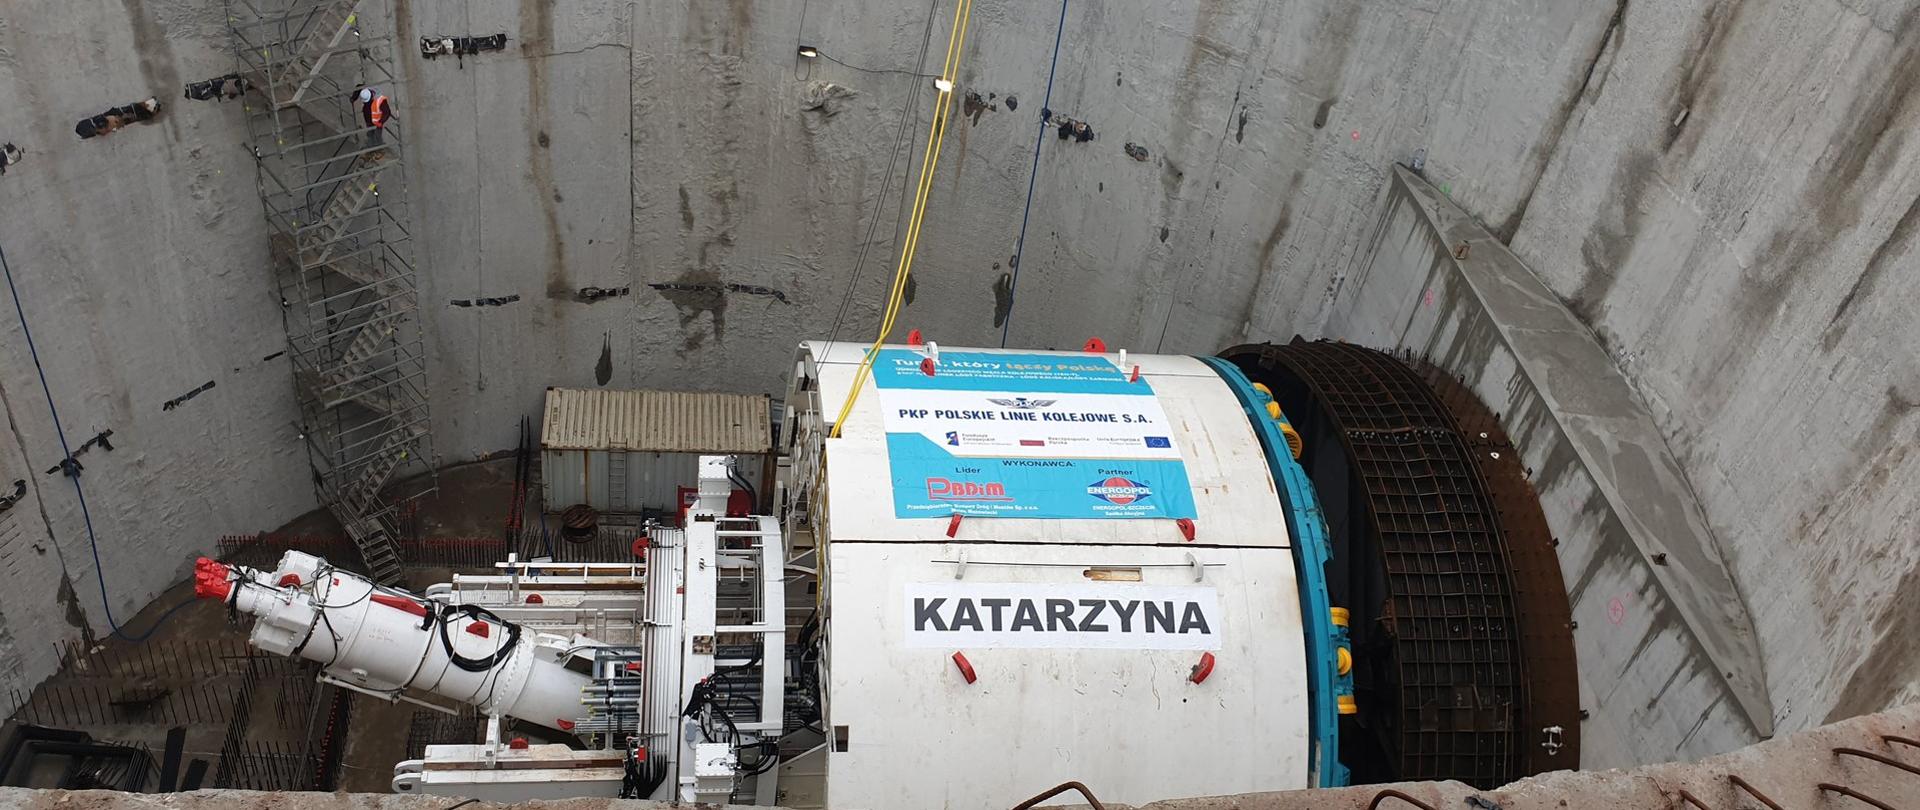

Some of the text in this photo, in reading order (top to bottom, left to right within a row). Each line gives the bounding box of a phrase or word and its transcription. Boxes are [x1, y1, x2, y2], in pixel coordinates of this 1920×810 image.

[952, 360, 1000, 369] który
[899, 409, 1153, 423] PKP POLSKIE LINIE KOLEJOWE S.A.
[1002, 460, 1077, 468] WYKONAWCA:
[1087, 487, 1153, 495] ENERGOPOL
[914, 597, 1211, 634] KATARZYNA
